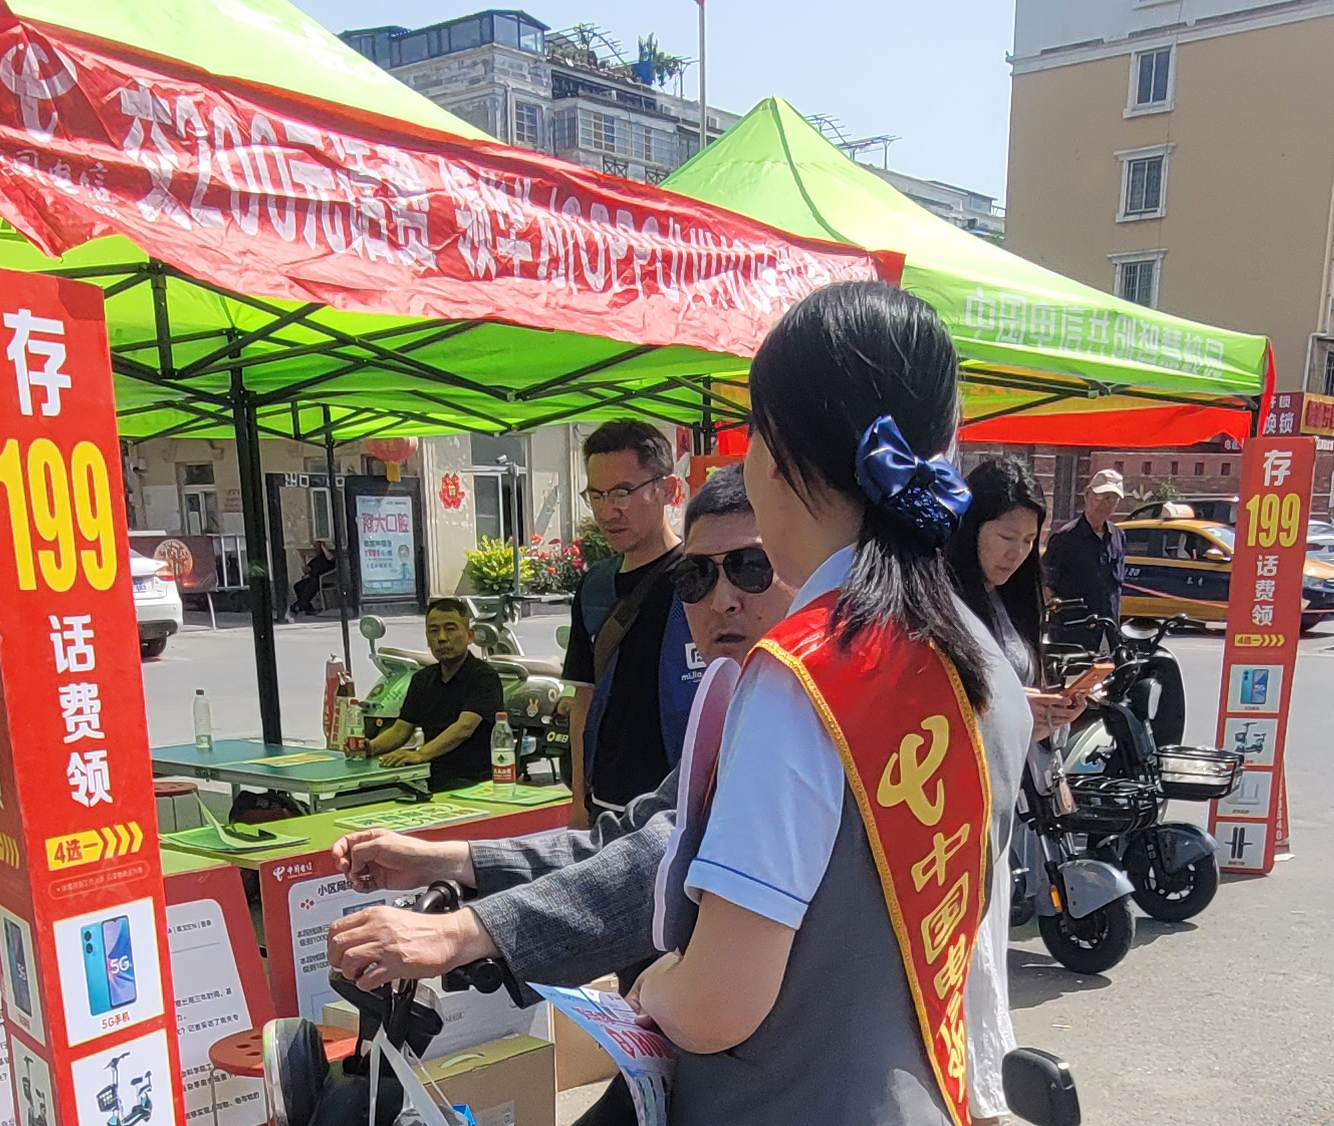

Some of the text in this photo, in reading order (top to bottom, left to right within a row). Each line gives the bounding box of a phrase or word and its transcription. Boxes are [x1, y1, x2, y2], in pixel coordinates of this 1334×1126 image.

[3, 309, 71, 416] 存
[1262, 449, 1293, 487] 存
[1246, 493, 1301, 548] 199
[1251, 554, 1279, 627] 话费领
[48, 614, 114, 809] 话费领
[53, 838, 100, 865] 4选一
[110, 955, 131, 975] 5G
[101, 1010, 131, 1029] 5G手机
